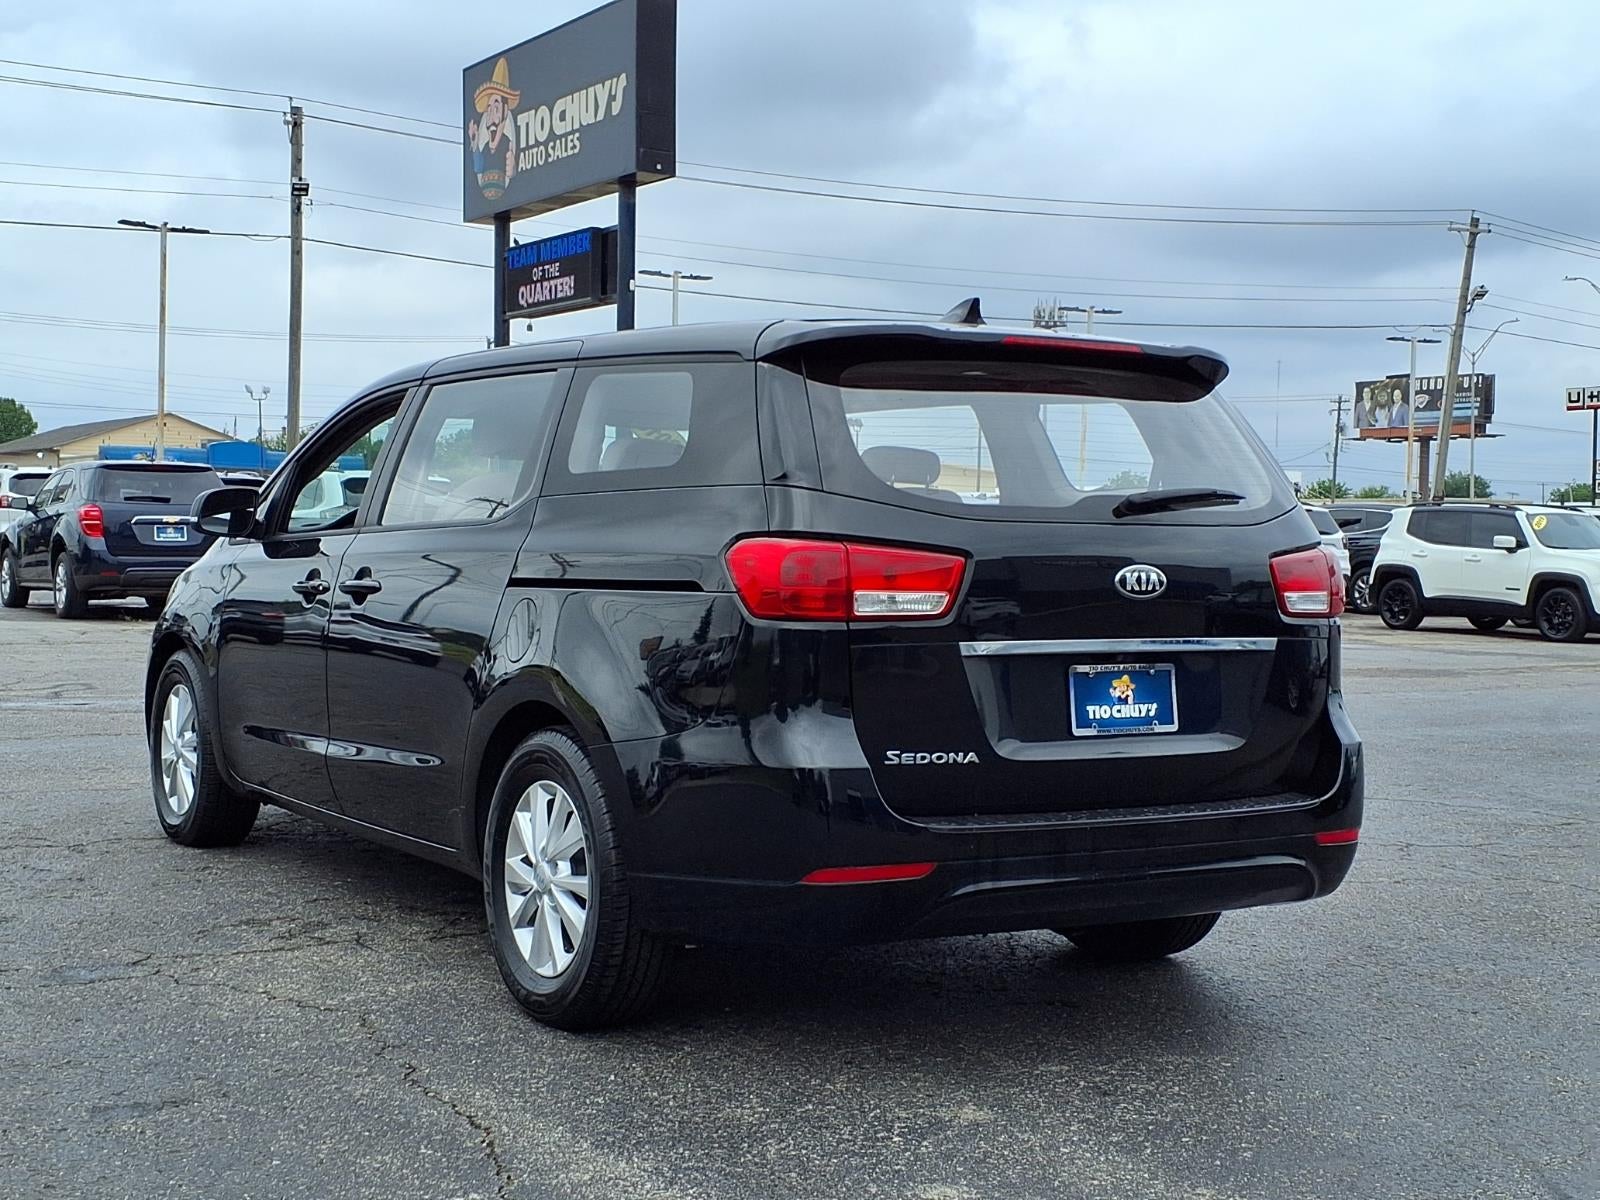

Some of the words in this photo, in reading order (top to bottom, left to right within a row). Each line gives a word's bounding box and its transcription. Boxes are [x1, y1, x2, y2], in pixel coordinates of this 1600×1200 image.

[517, 105, 549, 149] TIO
[552, 73, 627, 136] CHUY'S
[518, 149, 545, 173] AUTO
[548, 132, 580, 162] SALES
[508, 245, 537, 269] TEAM
[540, 231, 591, 261] MEMBER
[532, 266, 543, 281] OF
[544, 262, 560, 278] THE
[518, 275, 575, 308] QUARTER!
[1125, 571, 1160, 591] KIA
[1086, 704, 1111, 720] TIO
[1112, 702, 1158, 718] CHUY'S
[884, 750, 980, 765] SEDONA
